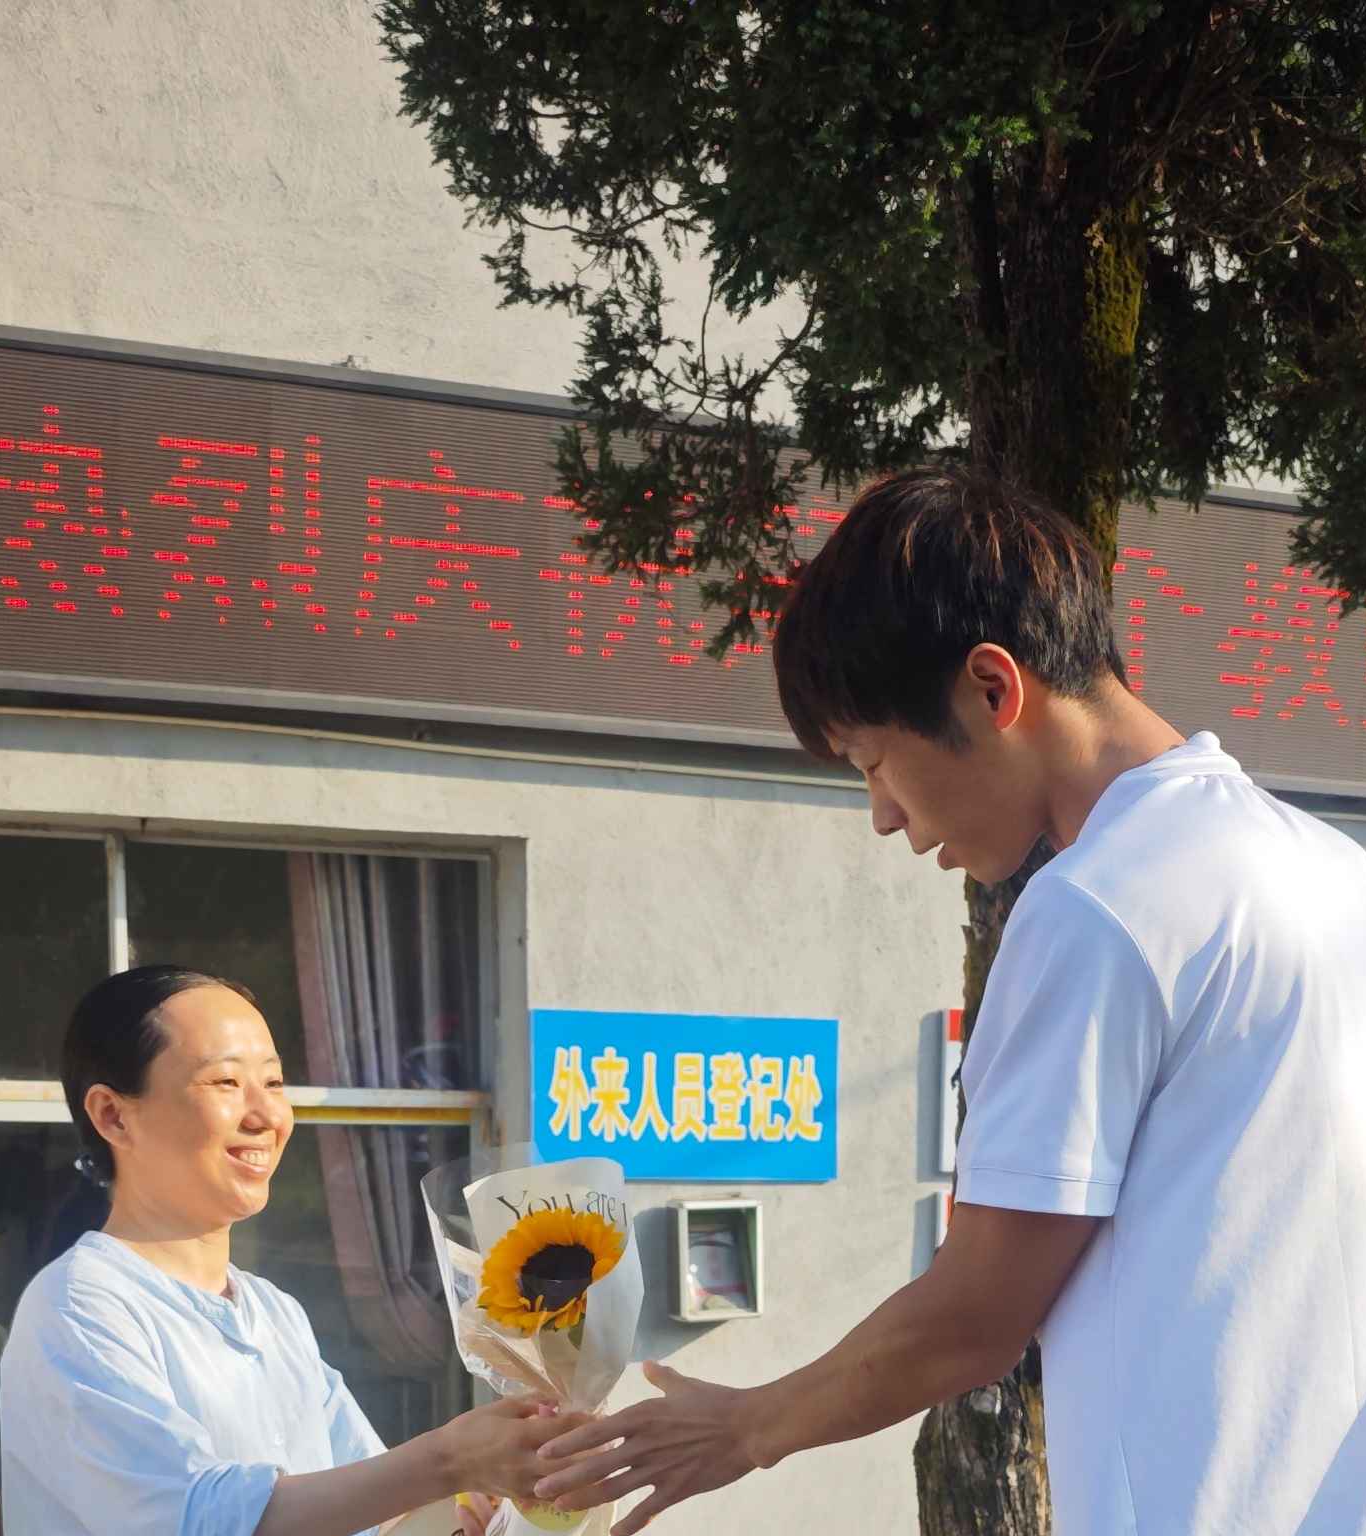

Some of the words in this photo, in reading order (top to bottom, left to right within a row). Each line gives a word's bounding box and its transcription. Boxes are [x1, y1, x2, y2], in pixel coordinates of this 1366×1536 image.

[548, 1045, 824, 1143] 外来人员登记处
